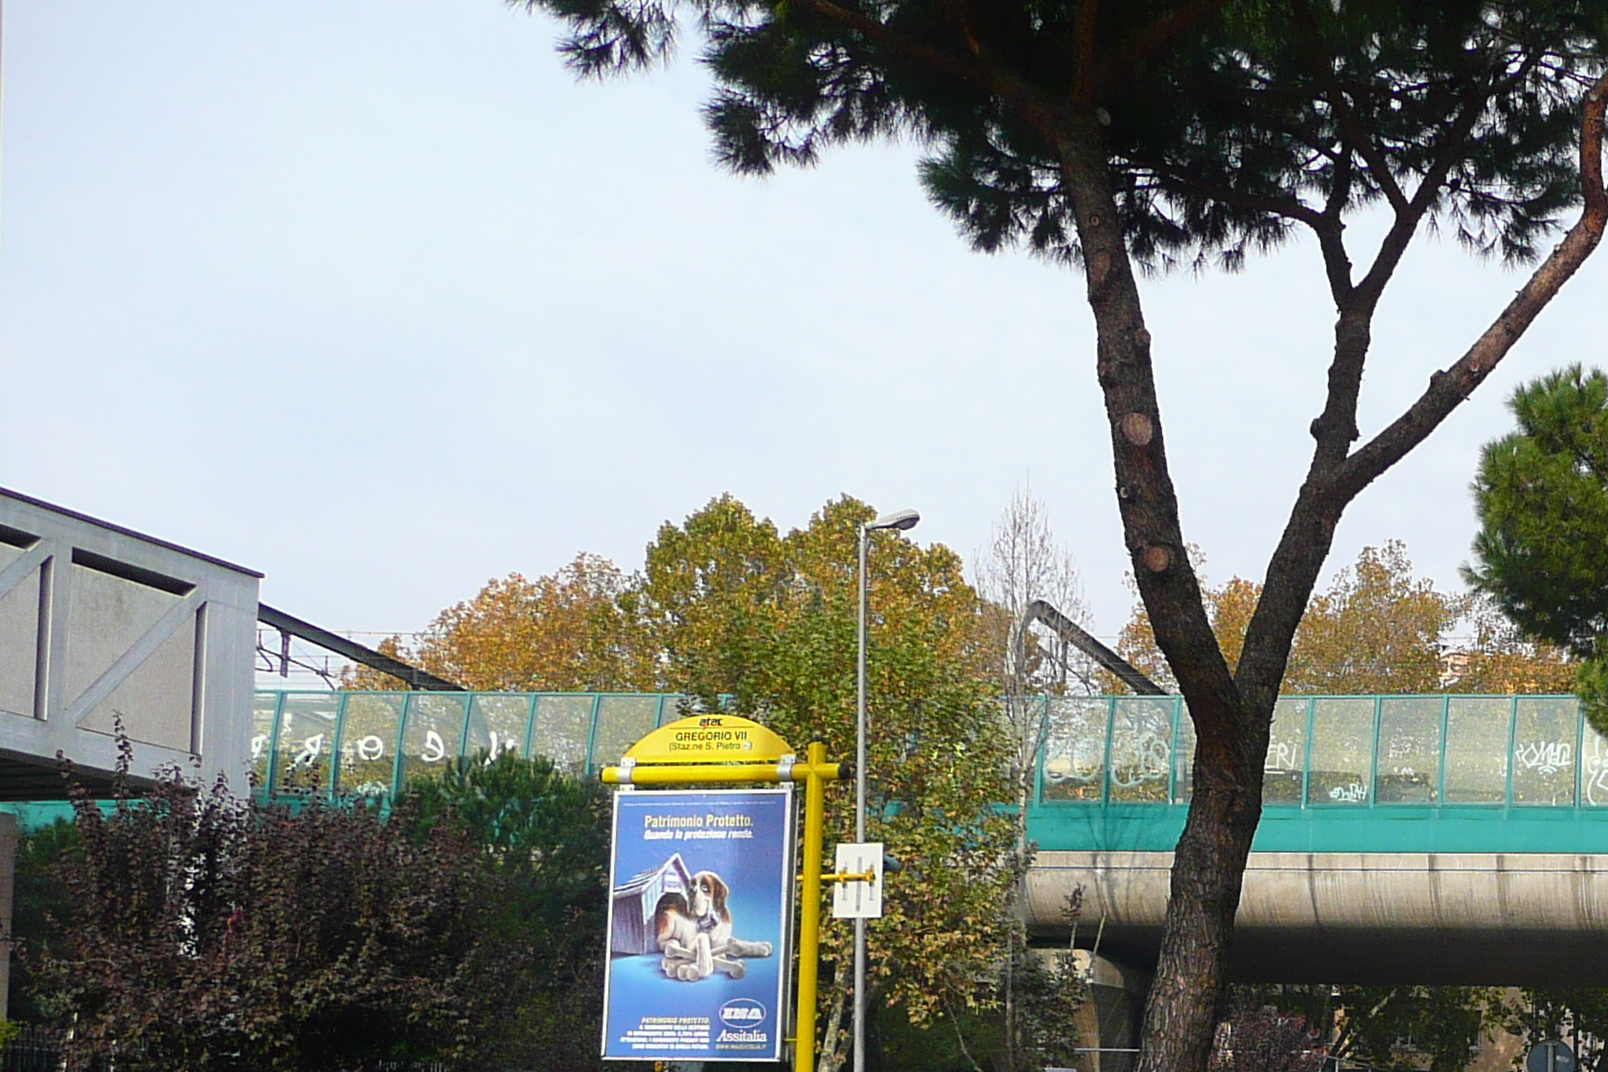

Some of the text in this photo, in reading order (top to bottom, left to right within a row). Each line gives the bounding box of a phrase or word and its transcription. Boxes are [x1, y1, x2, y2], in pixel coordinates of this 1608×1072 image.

[675, 731, 747, 742] GREGORIO VII
[644, 814, 754, 828] Patrimonio Protetto.
[723, 1008, 763, 1019] INA
[716, 1029, 767, 1042] Assitalia
